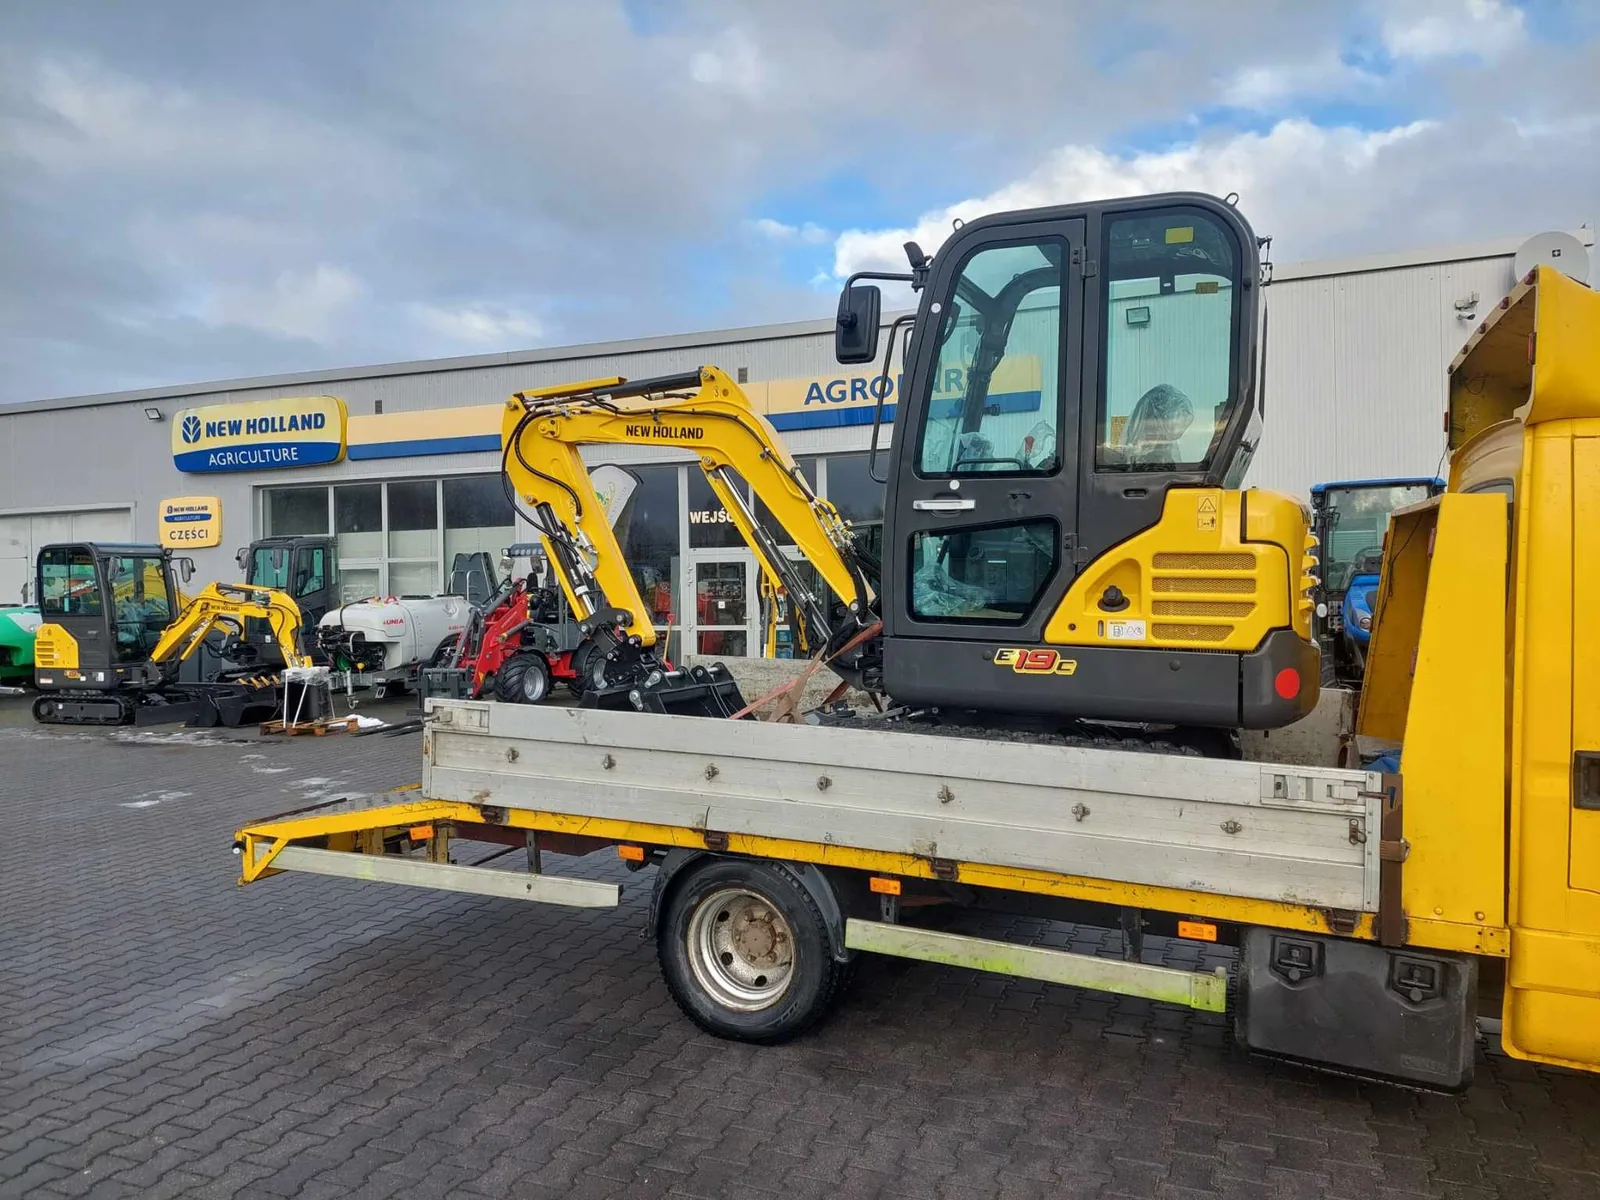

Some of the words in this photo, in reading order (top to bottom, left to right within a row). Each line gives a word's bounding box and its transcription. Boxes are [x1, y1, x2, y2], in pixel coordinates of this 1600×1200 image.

[206, 420, 242, 437] NEW
[246, 413, 326, 435] HOLLAND
[626, 425, 651, 437] NEW
[653, 426, 704, 439] HOLLAND
[208, 447, 299, 467] AGRICULTURE
[169, 527, 208, 542] CZĘŚCI
[995, 649, 1077, 672] E19C
